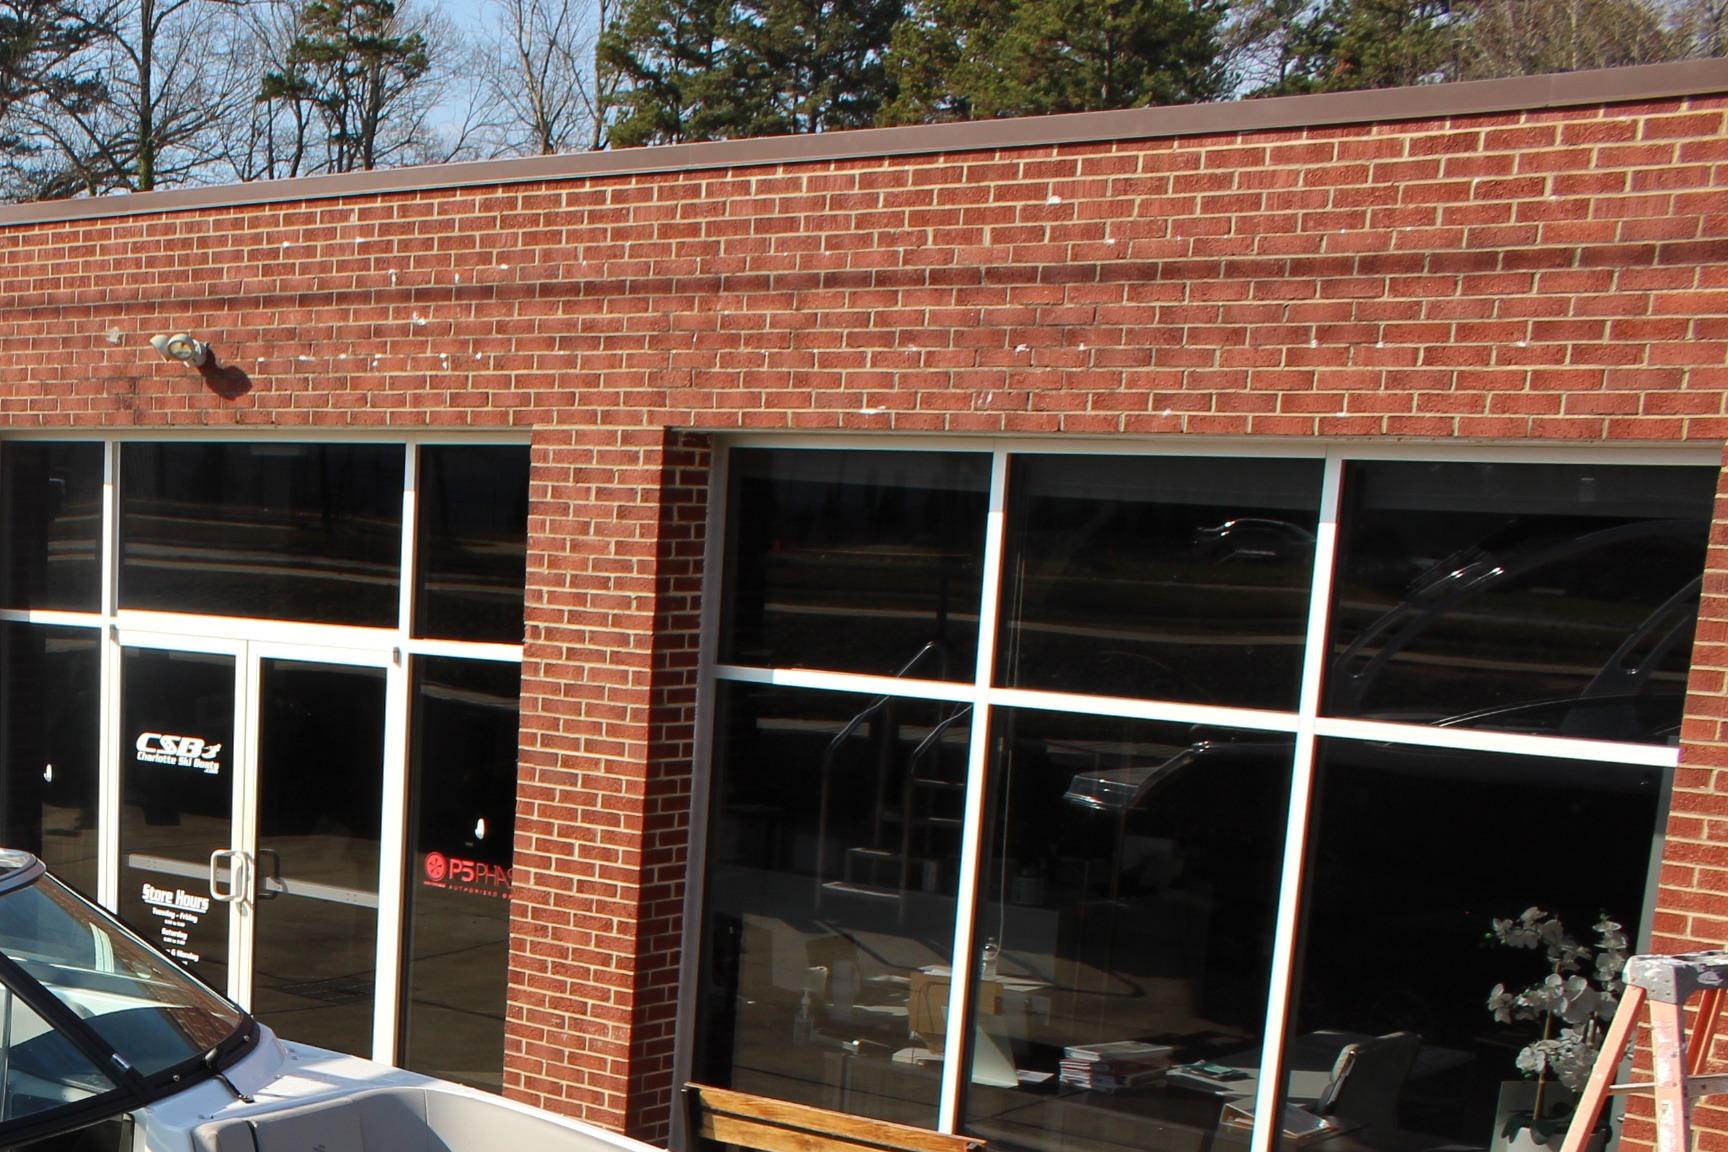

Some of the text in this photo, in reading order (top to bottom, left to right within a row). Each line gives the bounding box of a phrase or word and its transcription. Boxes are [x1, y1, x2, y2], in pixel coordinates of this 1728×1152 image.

[136, 732, 205, 758] CSB
[142, 883, 209, 910] Store Hours
